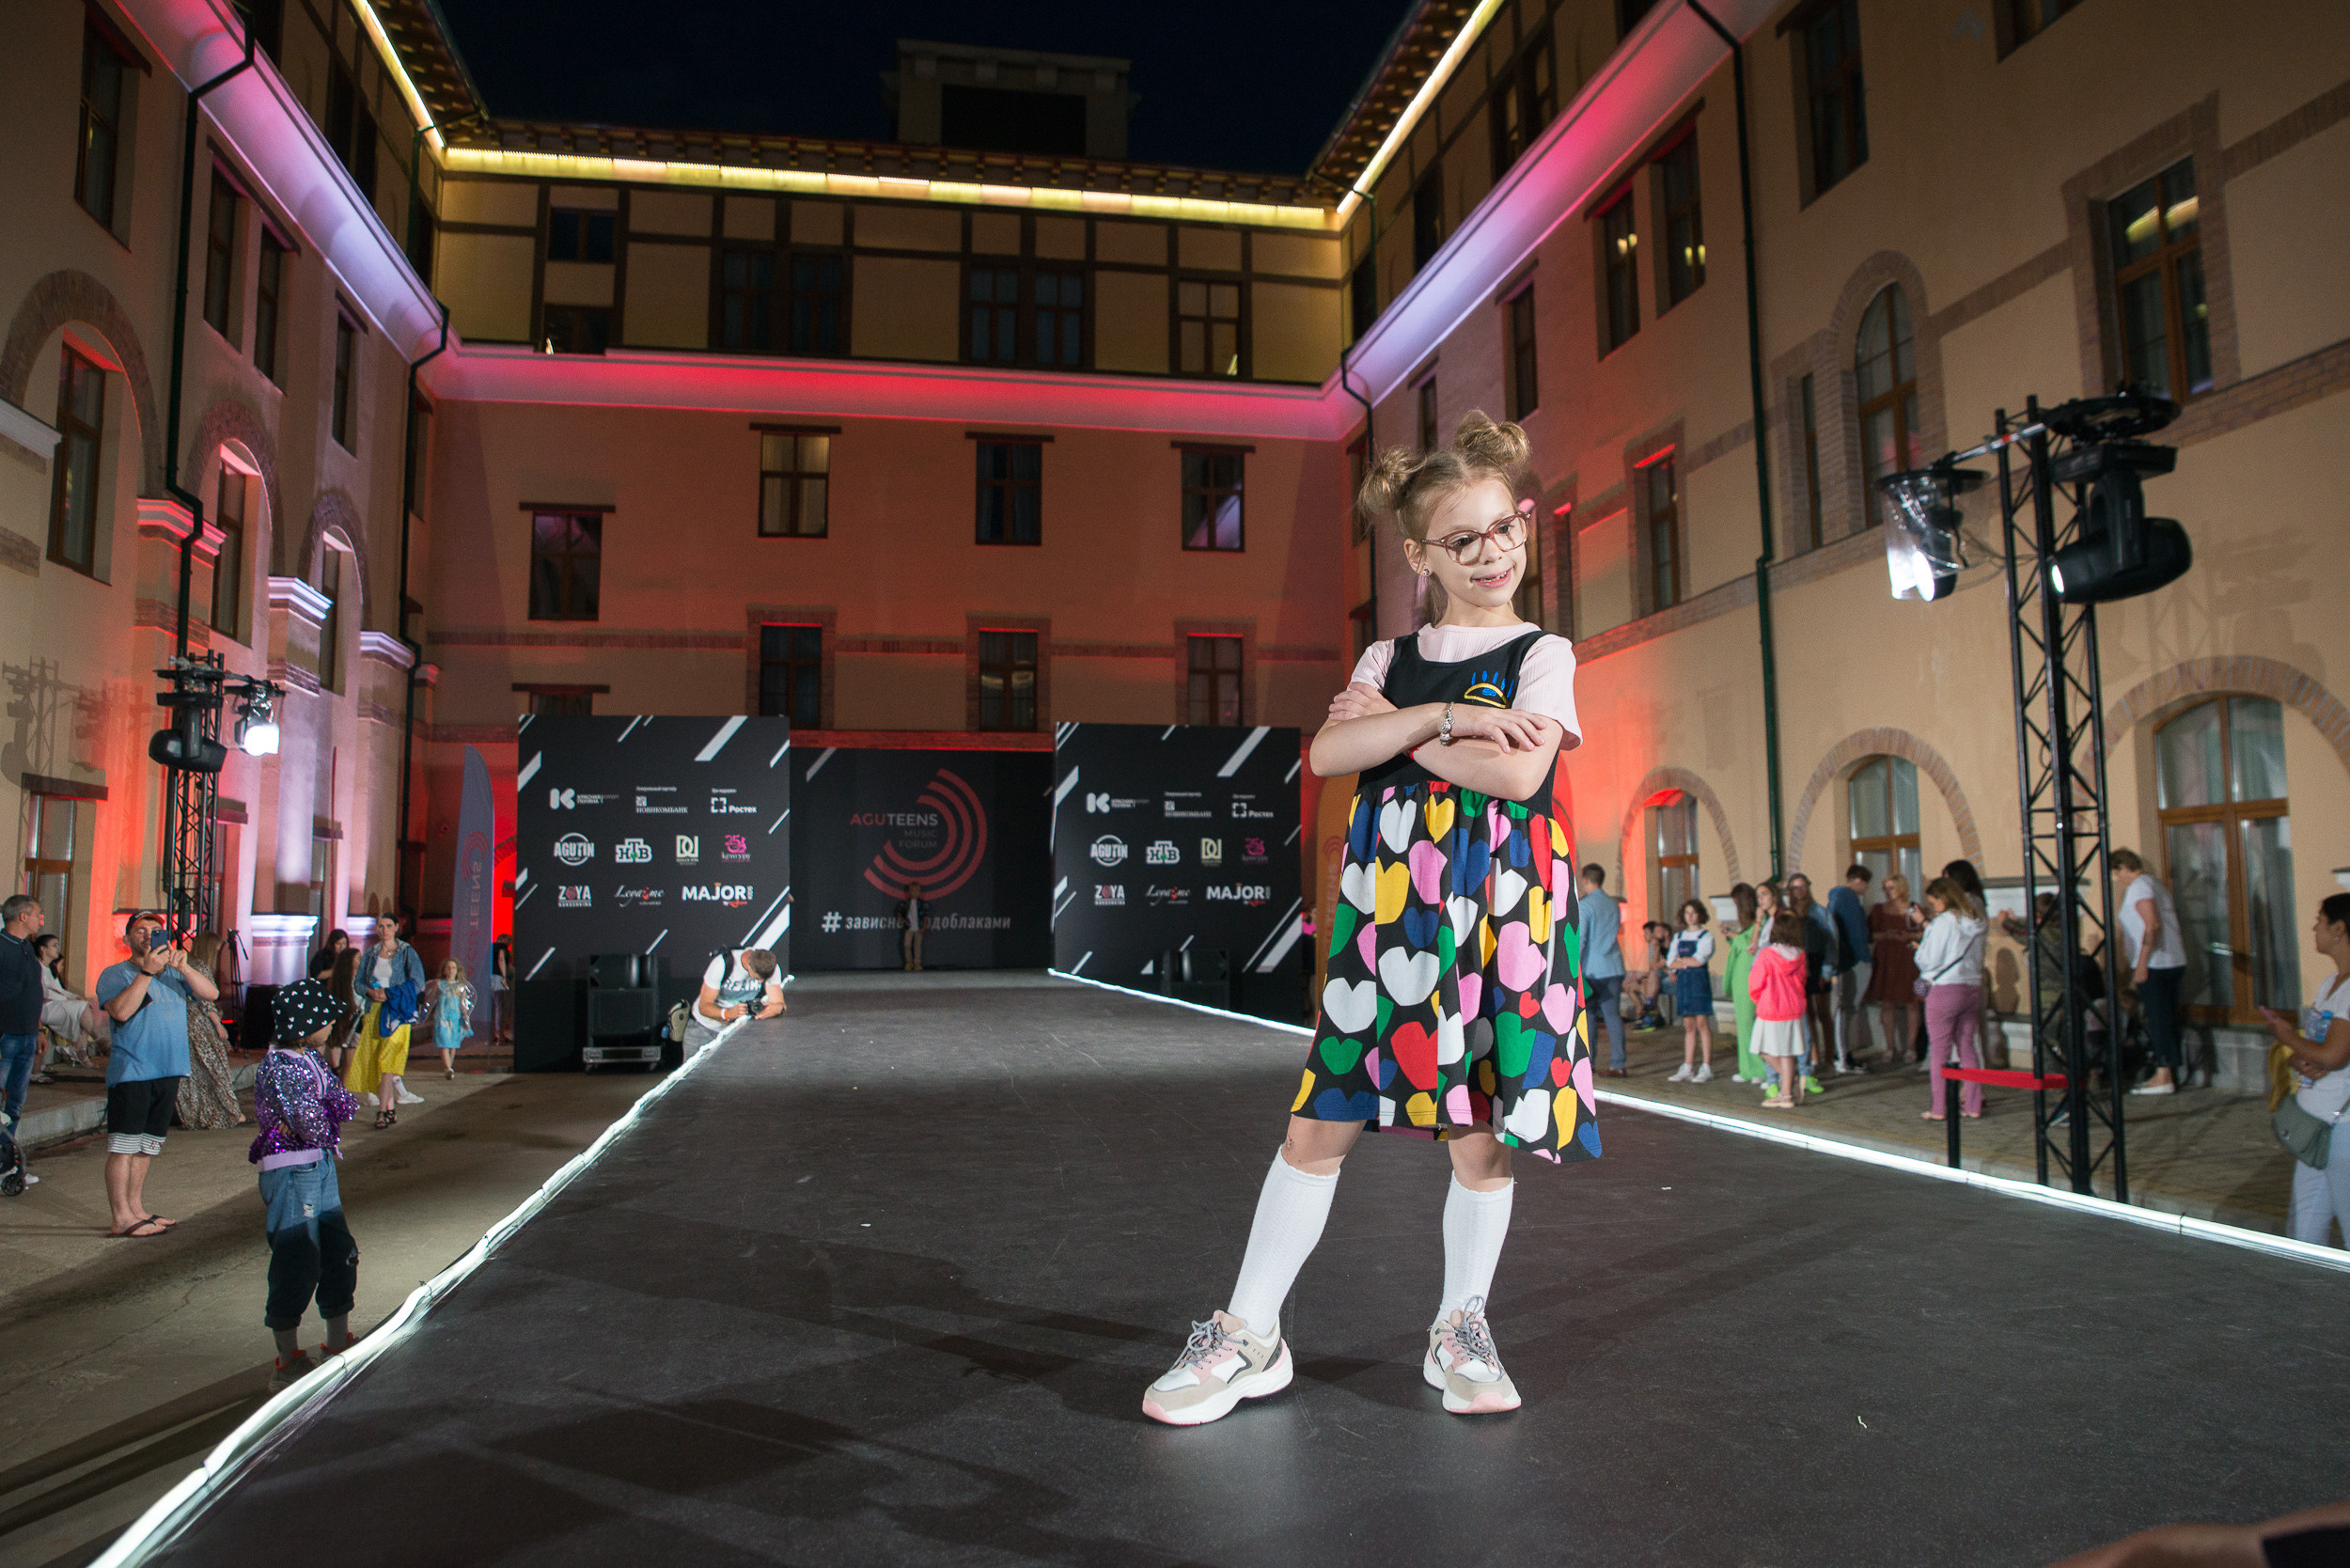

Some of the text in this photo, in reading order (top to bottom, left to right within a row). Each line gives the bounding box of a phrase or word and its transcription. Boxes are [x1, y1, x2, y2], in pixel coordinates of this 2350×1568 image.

[728, 805, 757, 813] Ростех
[850, 813, 938, 826] AGUTEENS
[903, 829, 938, 839] MUSIC
[554, 841, 595, 857] AGUTIN
[616, 838, 652, 863] НТВ
[898, 839, 938, 849] FORUM
[1090, 843, 1128, 859] AGUTIN
[558, 886, 591, 900] ZOYA
[682, 885, 746, 901] MAJOR
[1206, 886, 1264, 900] MAJOR
